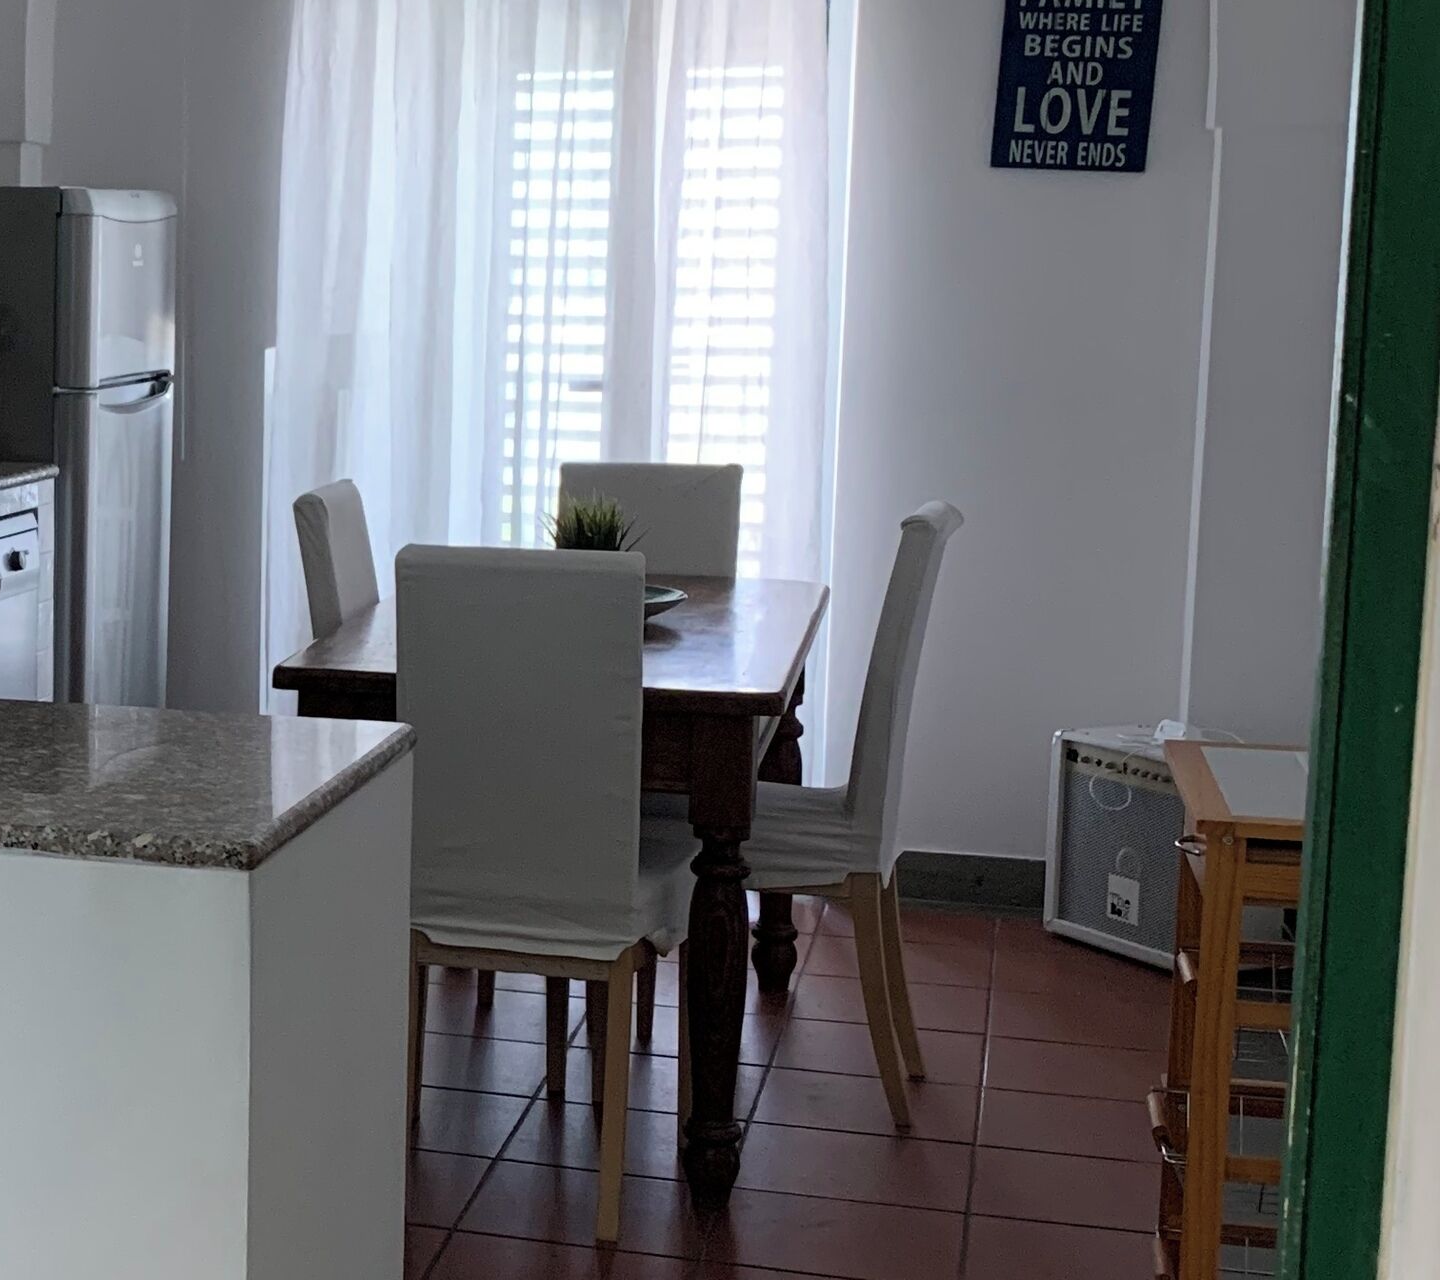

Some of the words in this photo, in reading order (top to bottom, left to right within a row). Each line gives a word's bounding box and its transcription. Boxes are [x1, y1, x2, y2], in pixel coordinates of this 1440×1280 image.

[1019, 11, 1091, 32] WHERE
[1101, 13, 1144, 33] LIFE
[1024, 34, 1134, 60] BEGINS
[1046, 61, 1104, 86] AND
[1013, 86, 1133, 137] LOVE
[1008, 139, 1069, 166] NEVER
[1076, 142, 1127, 168] ENDS
